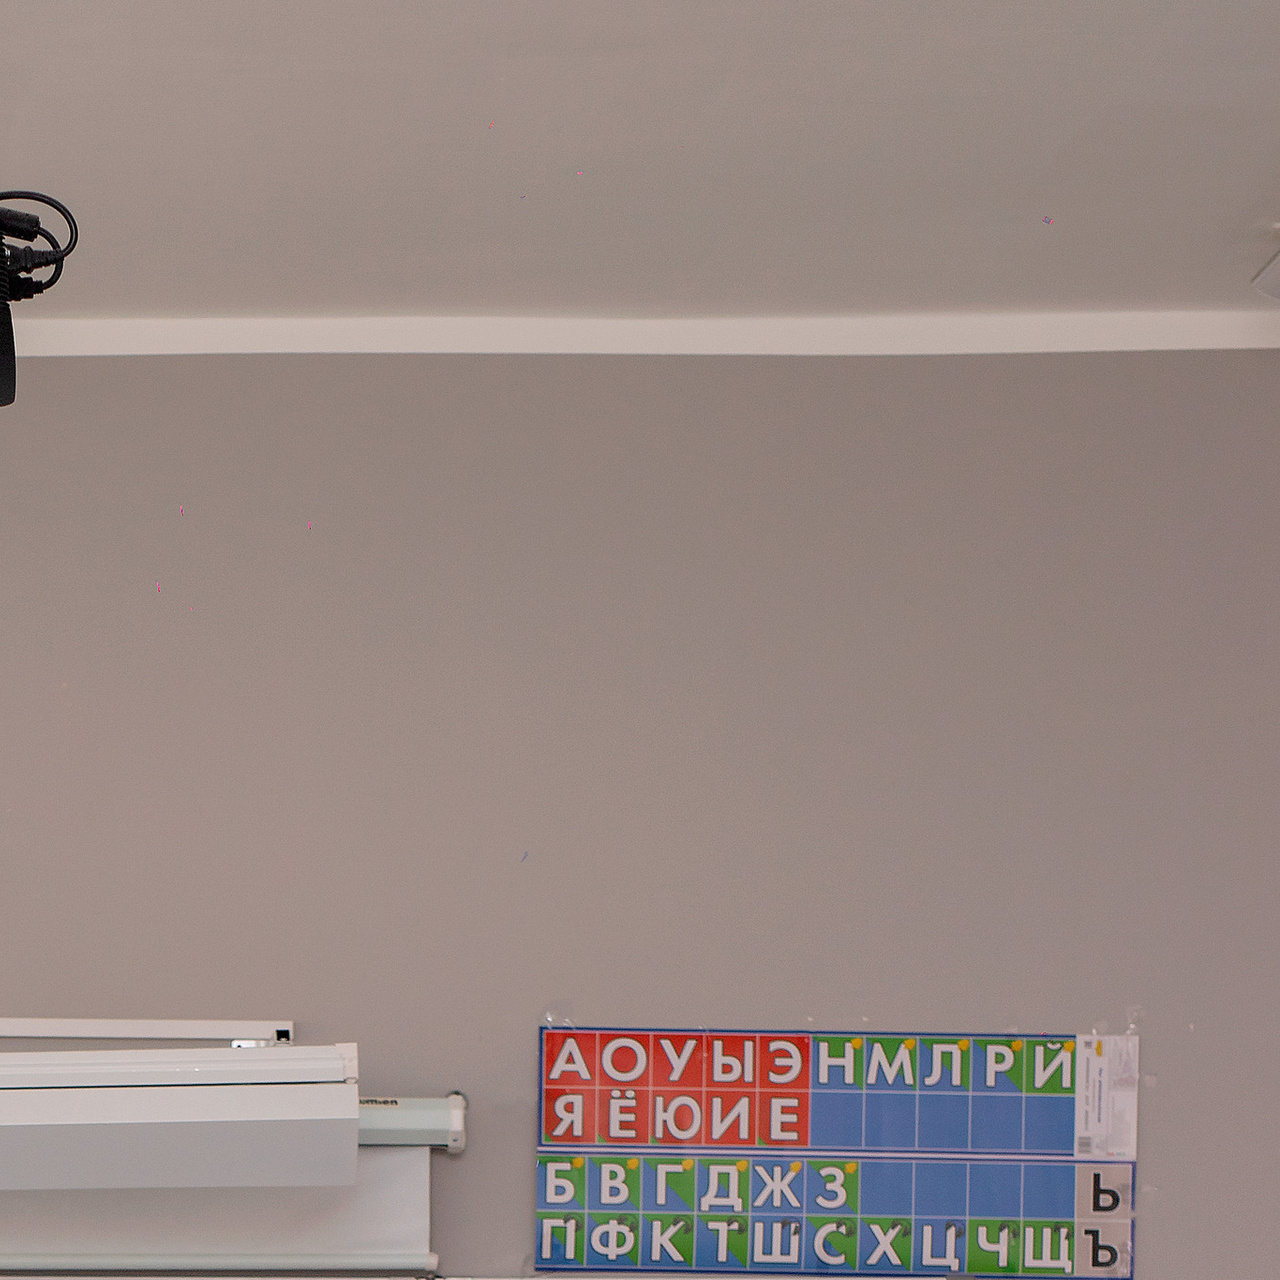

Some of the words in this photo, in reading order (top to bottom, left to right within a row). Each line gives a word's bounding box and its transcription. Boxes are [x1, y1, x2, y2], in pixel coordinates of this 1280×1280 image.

[549, 1038, 591, 1081] А
[601, 1039, 647, 1082] О
[657, 1040, 697, 1081] У
[713, 1043, 753, 1082] Ы
[768, 1041, 803, 1083] Э
[819, 1043, 855, 1084] Н
[868, 1045, 914, 1085] М
[924, 1045, 962, 1086] Л
[987, 1043, 1014, 1087] Р
[1033, 1040, 1072, 1089] Й
[553, 1095, 584, 1137] Я
[609, 1090, 637, 1138] Ё
[656, 1095, 702, 1140] Ю
[712, 1097, 749, 1140] И
[771, 1098, 798, 1140] Е
[545, 1163, 574, 1204] Б
[600, 1164, 629, 1205] В
[656, 1164, 683, 1205] Г
[701, 1166, 742, 1211] Д
[753, 1166, 800, 1207] Ж
[816, 1166, 847, 1208] З
[1092, 1173, 1120, 1214] Ь
[543, 1220, 575, 1259] П
[591, 1219, 634, 1261] Ф
[652, 1221, 686, 1262] К
[708, 1222, 740, 1263] Т
[754, 1222, 799, 1264] Ш
[813, 1223, 845, 1266] С
[867, 1224, 908, 1266] Х
[923, 1225, 958, 1271] Ц
[977, 1227, 1009, 1267] Ч
[1024, 1227, 1072, 1274] Щ
[1085, 1230, 1118, 1268] Ъ
